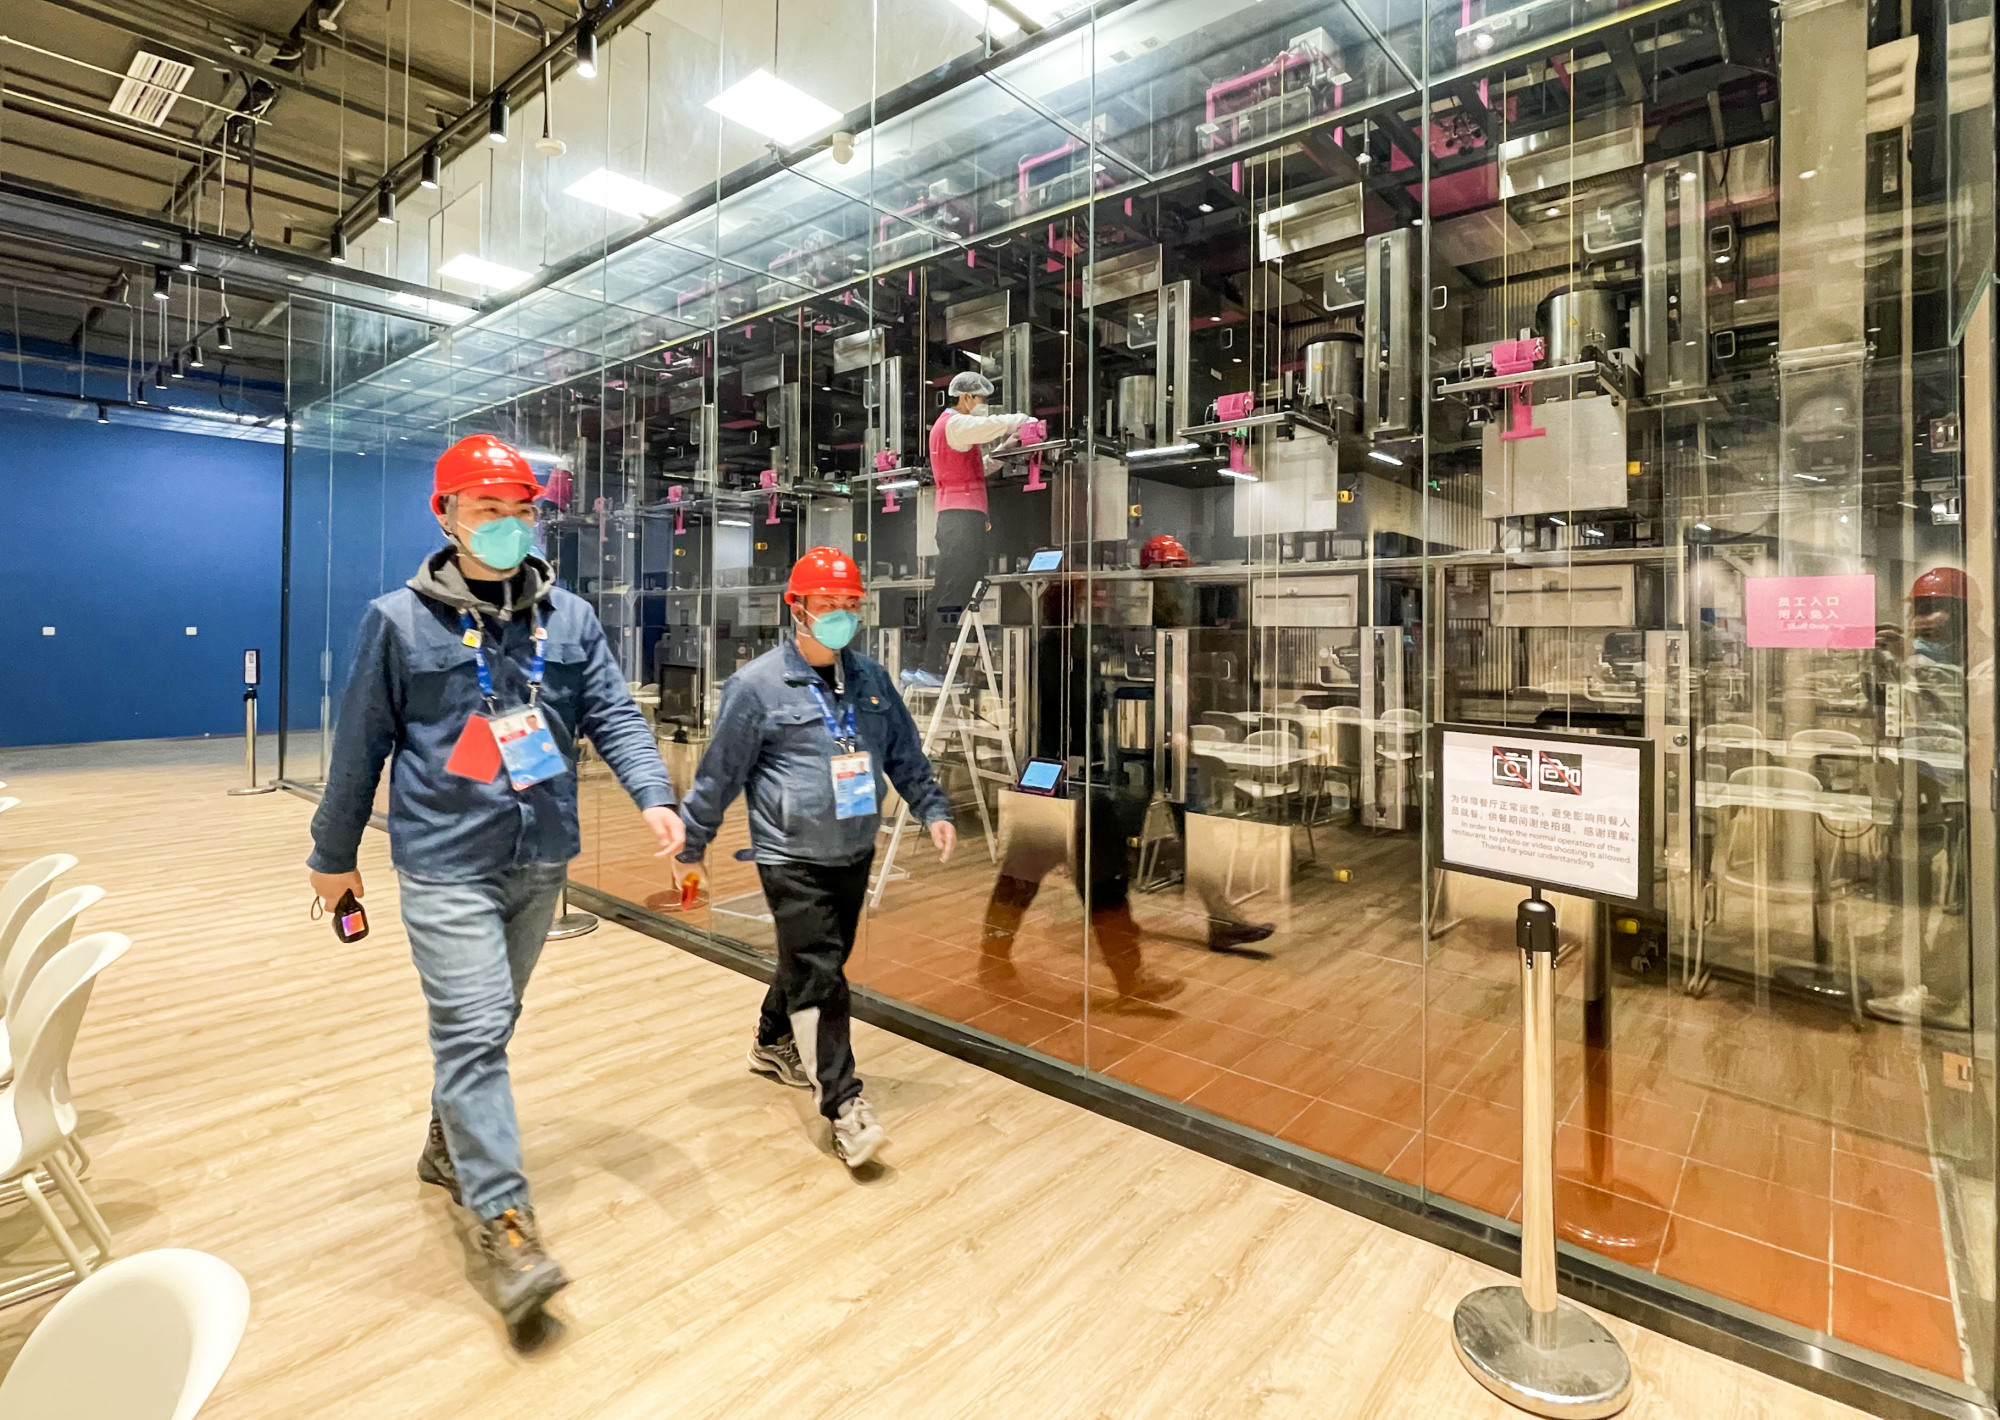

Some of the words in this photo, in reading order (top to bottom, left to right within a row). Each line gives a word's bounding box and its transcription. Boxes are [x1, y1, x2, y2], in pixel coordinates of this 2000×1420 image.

[1778, 596, 1839, 607] 员工入口
[1809, 622, 1830, 631] Only
[1469, 822, 1487, 830] order
[1497, 826, 1514, 836] keep
[1516, 830, 1528, 838] the
[1529, 833, 1556, 842] normal
[1557, 837, 1596, 848] operation
[1597, 842, 1606, 850] of
[1607, 844, 1621, 853] the
[1481, 841, 1506, 852] Thanks
[1518, 849, 1536, 858] your
[1499, 836, 1521, 846] photo
[1531, 841, 1553, 851] video
[1554, 845, 1588, 858] shooting
